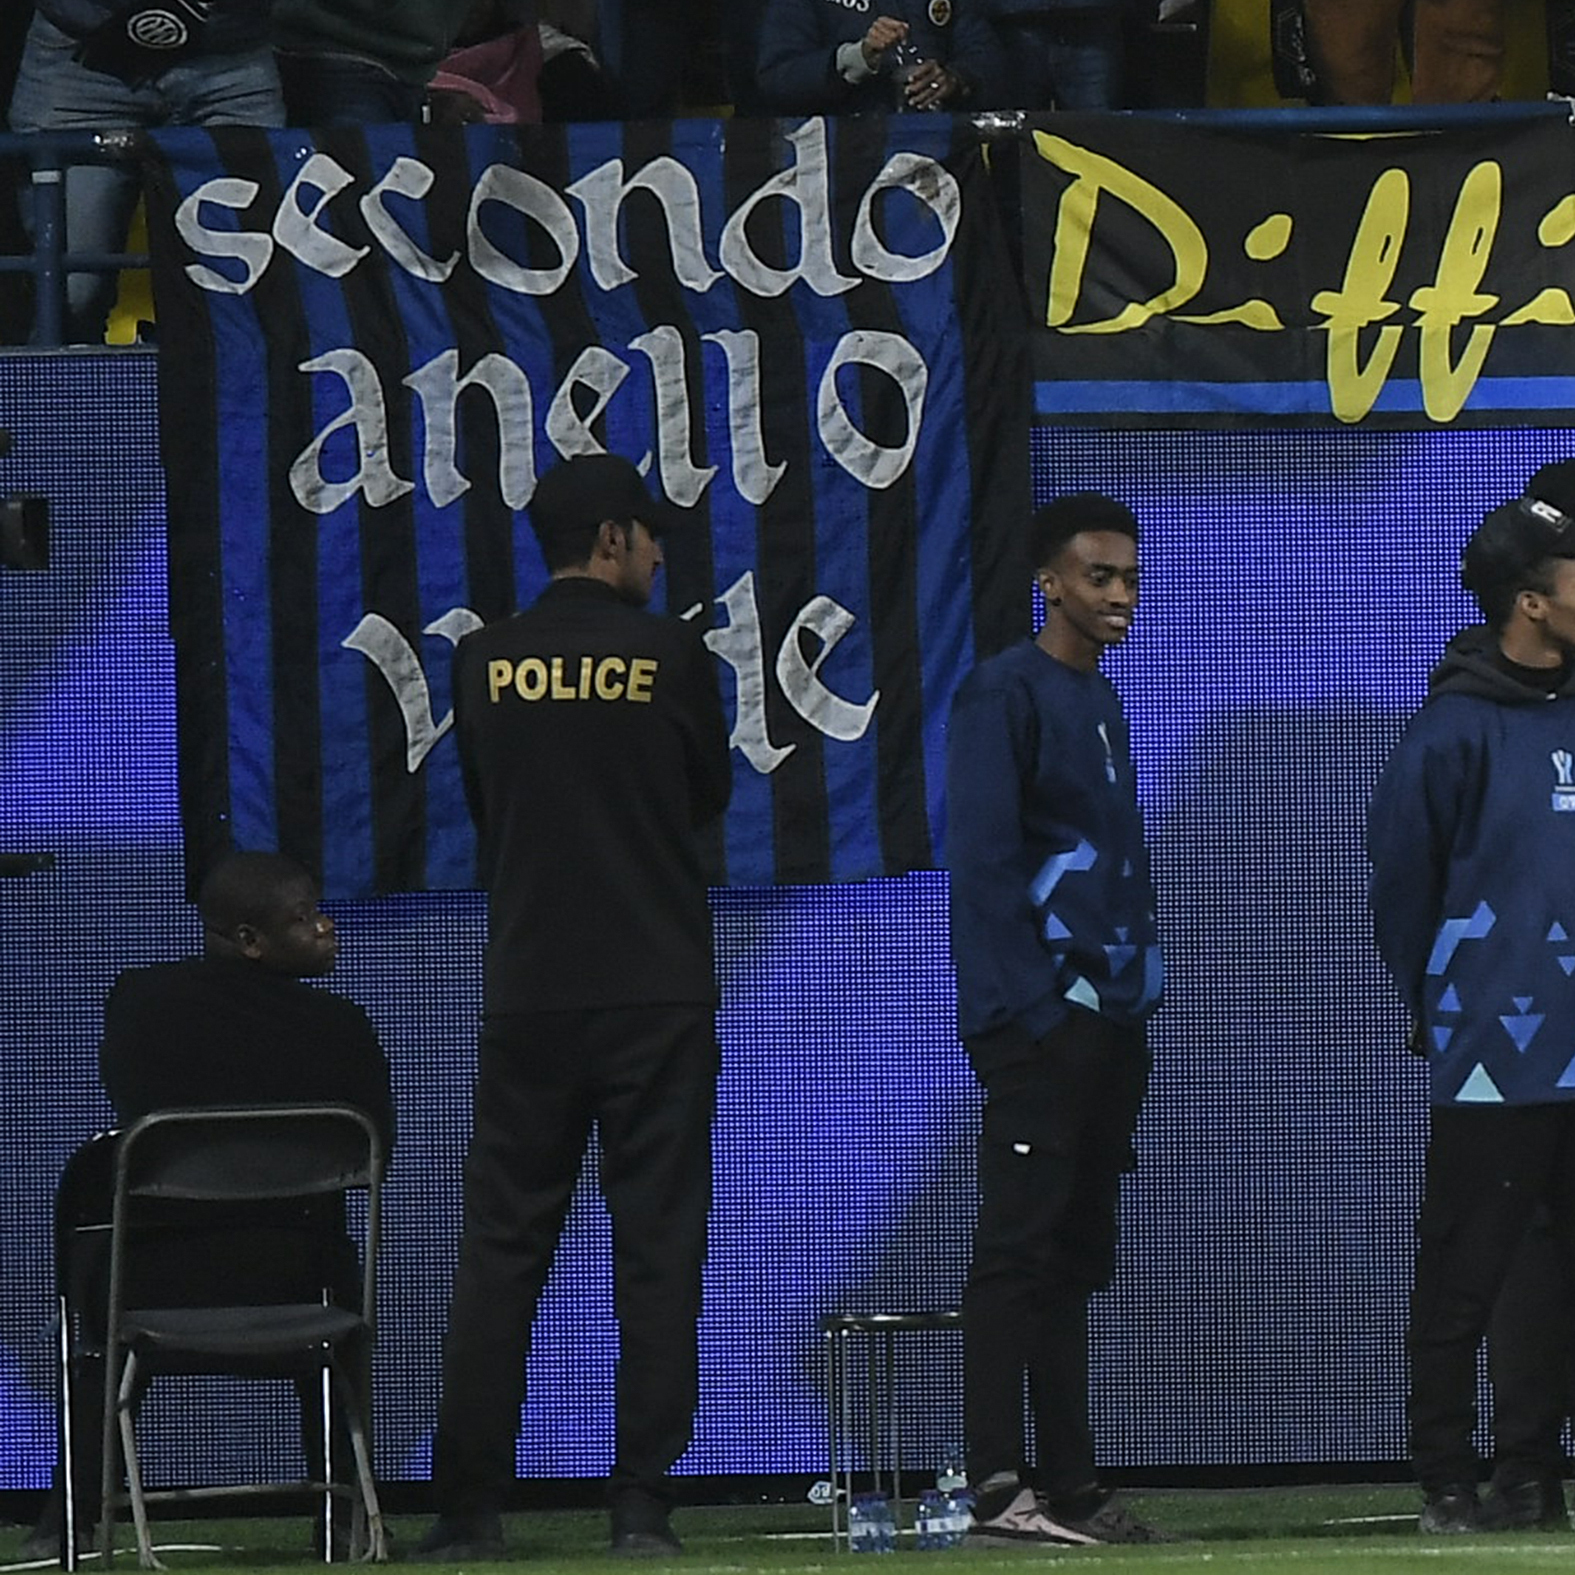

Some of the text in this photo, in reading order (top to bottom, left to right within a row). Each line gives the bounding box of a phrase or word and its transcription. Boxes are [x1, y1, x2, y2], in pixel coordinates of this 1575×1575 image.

[174, 116, 962, 297] secondo
[289, 325, 929, 514] anello
[486, 655, 660, 705] POLICE
